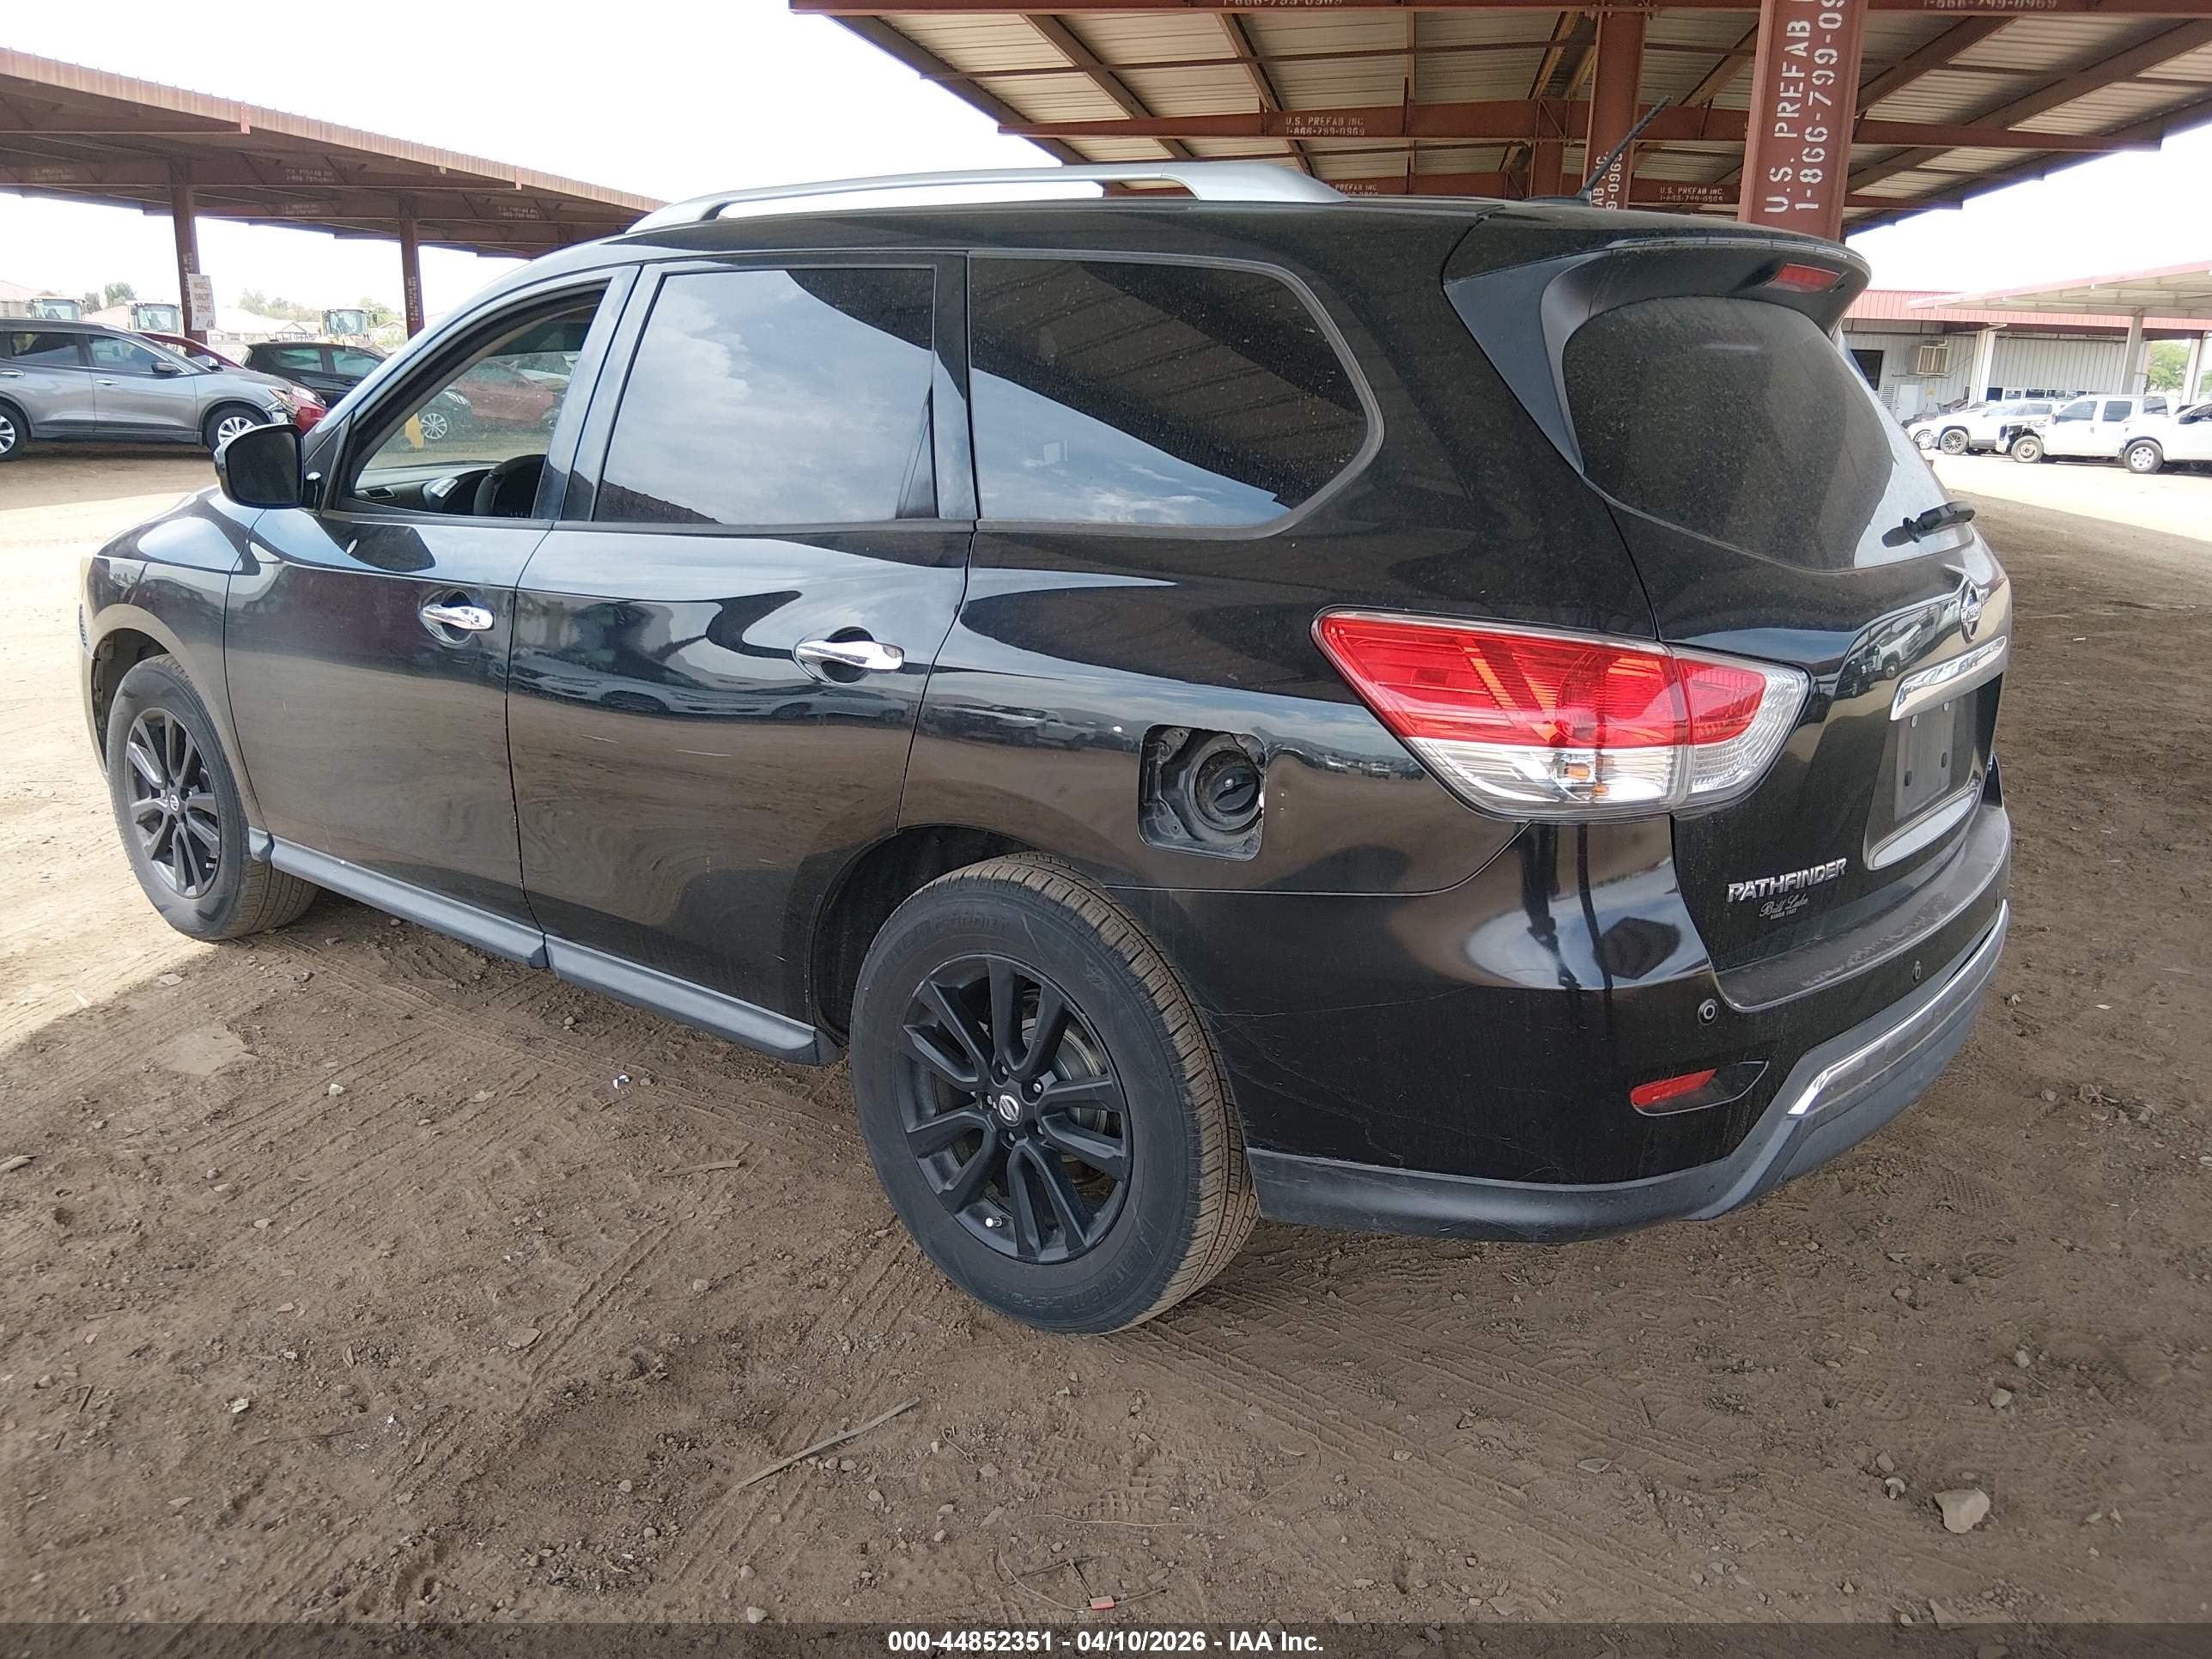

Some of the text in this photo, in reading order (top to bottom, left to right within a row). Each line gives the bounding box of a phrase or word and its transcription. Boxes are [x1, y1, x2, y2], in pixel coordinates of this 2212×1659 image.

[1773, 20, 1811, 137] PREFAB
[1285, 116, 1304, 126] U.S.
[1308, 117, 1345, 126] PREFAB
[1764, 157, 1796, 213] U.S.
[1726, 858, 1847, 902] PATHFINDER
[1759, 899, 1786, 917] Bill
